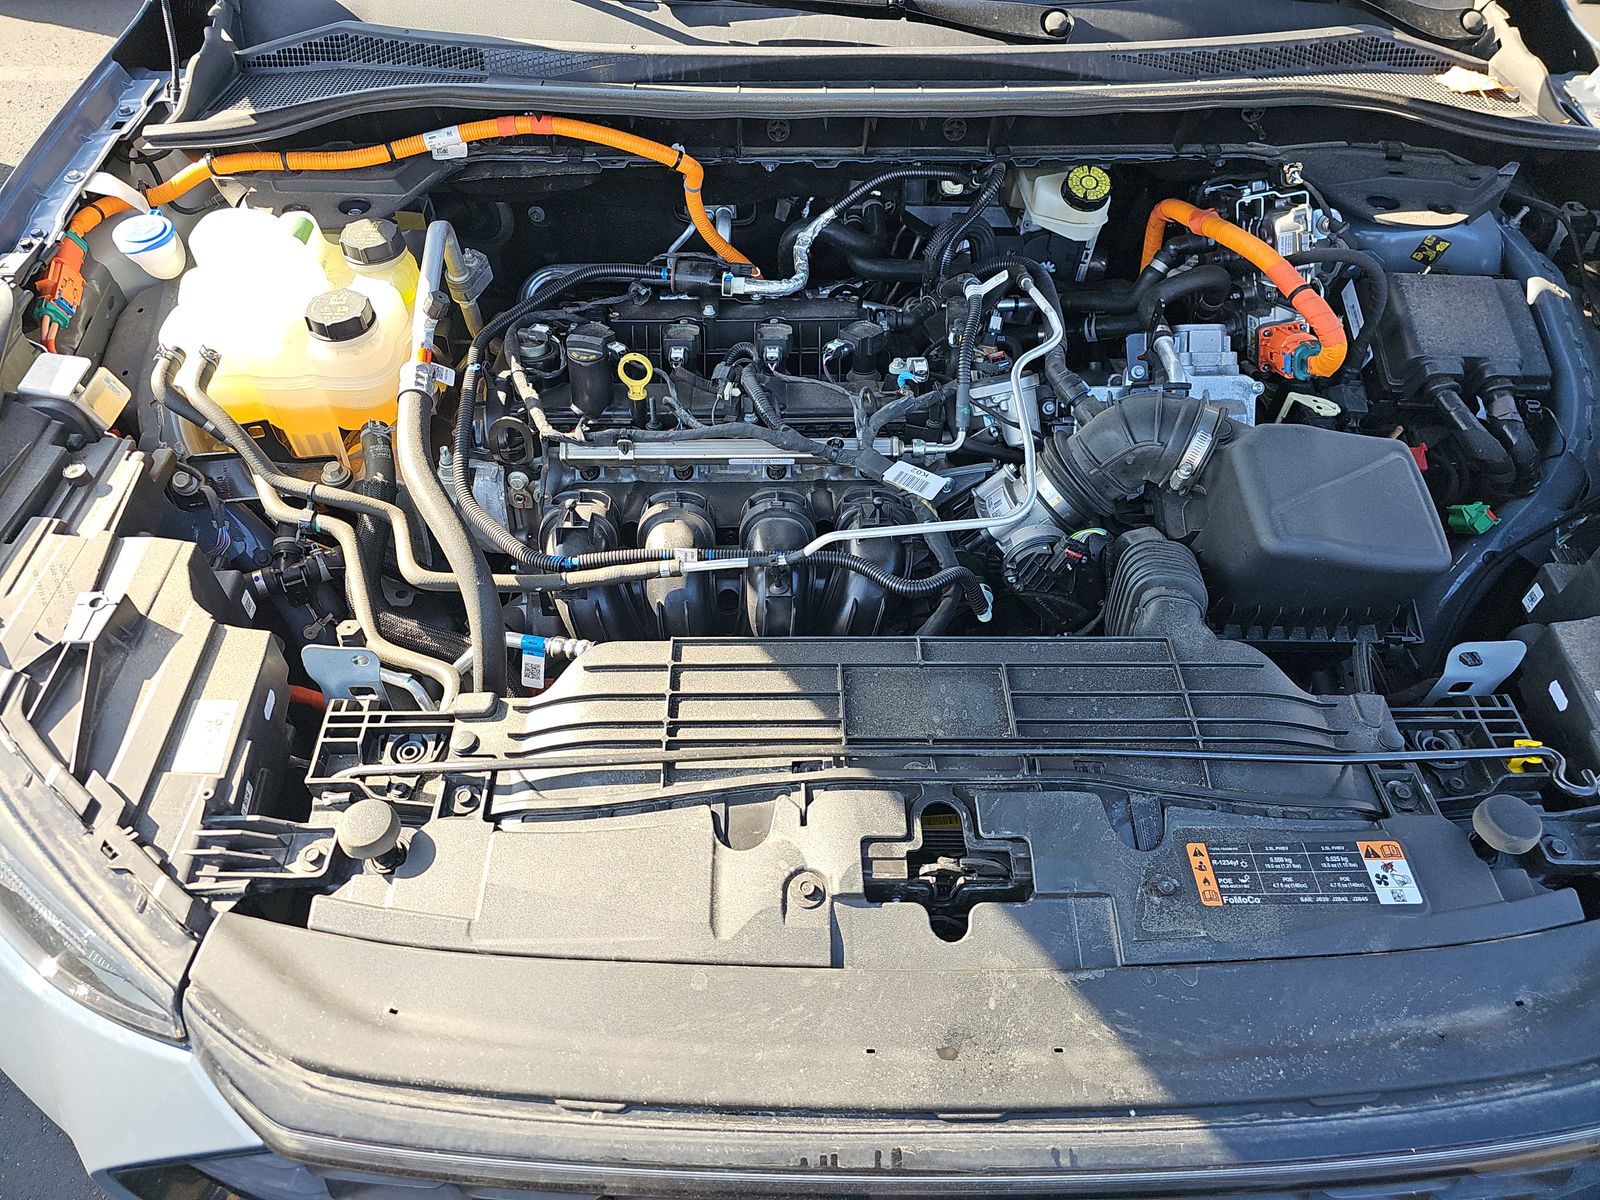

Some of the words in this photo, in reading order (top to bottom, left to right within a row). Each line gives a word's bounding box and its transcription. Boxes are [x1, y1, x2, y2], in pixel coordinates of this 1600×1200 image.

[910, 467, 930, 478] K02
[1212, 859, 1239, 867] R-1234yf
[1284, 856, 1292, 864] kg
[1222, 896, 1261, 904] FoMoCo
